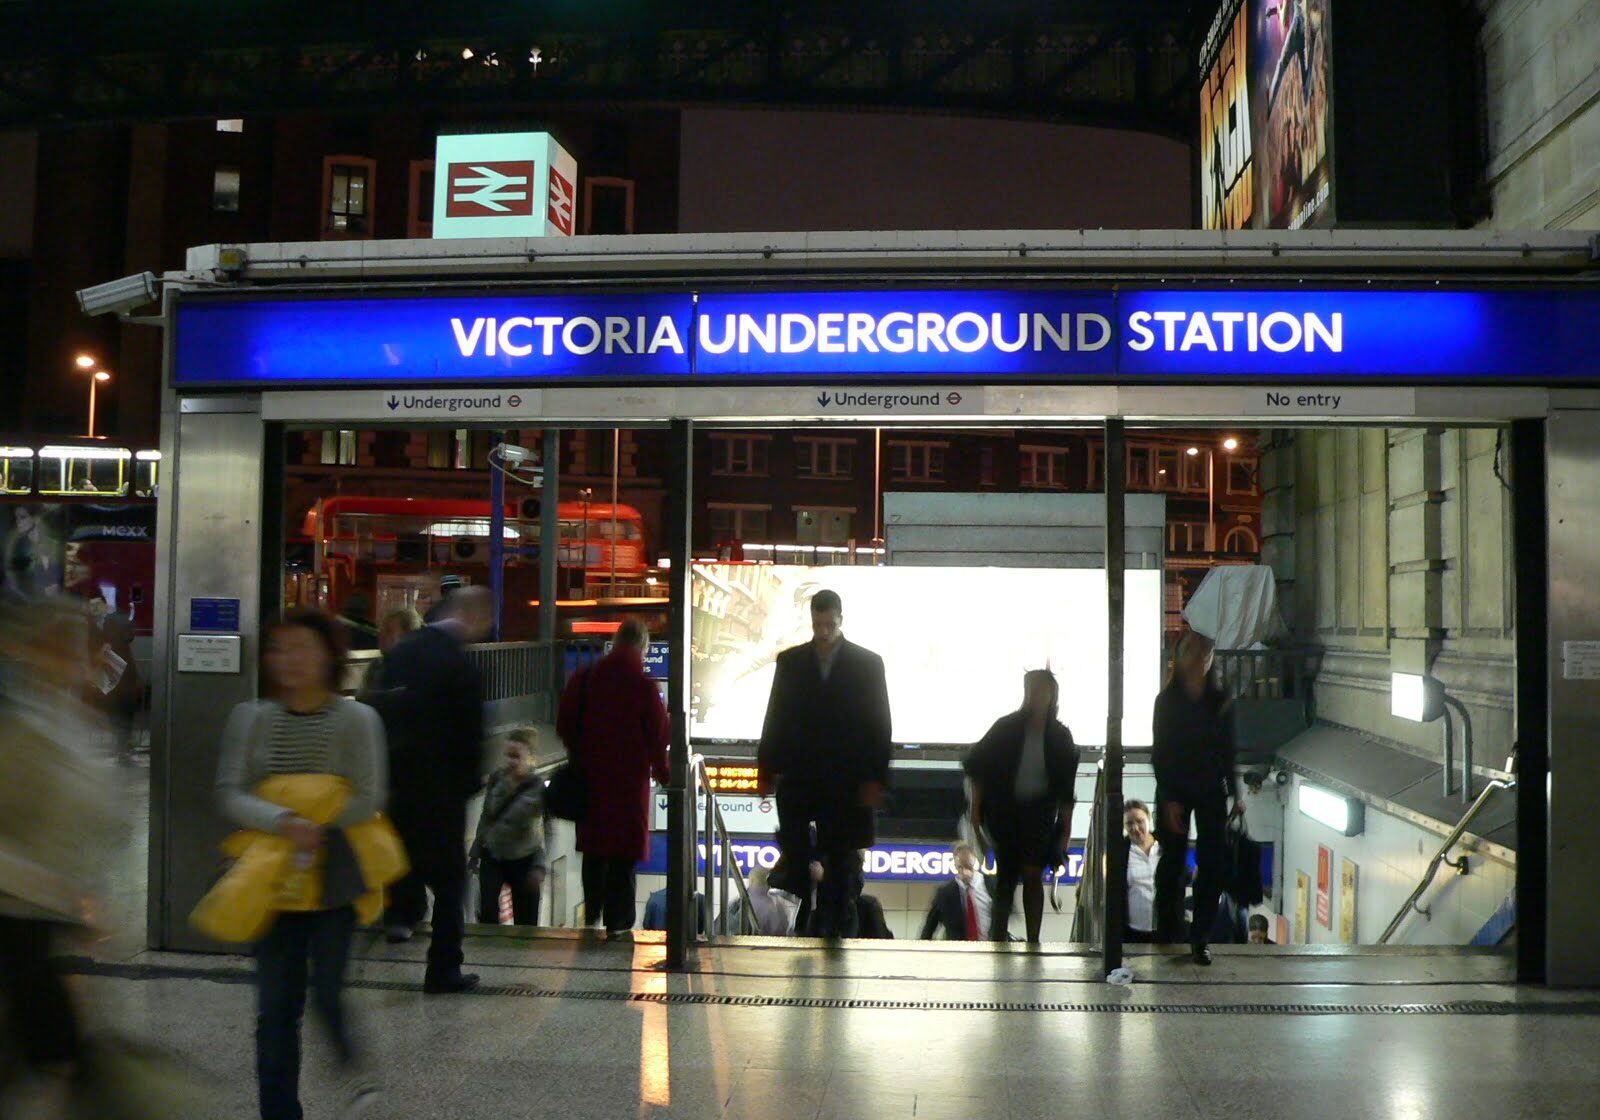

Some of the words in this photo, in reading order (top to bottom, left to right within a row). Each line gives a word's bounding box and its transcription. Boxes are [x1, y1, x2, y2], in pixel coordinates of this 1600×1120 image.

[451, 316, 684, 356] VICTORIA
[700, 312, 1112, 353] UNDERGROUND
[1127, 311, 1343, 352] STATION
[403, 395, 501, 411] Underground
[835, 392, 940, 409] Underground
[1266, 392, 1290, 406] No
[1297, 393, 1341, 409] entry
[720, 767, 759, 778] VICTORI
